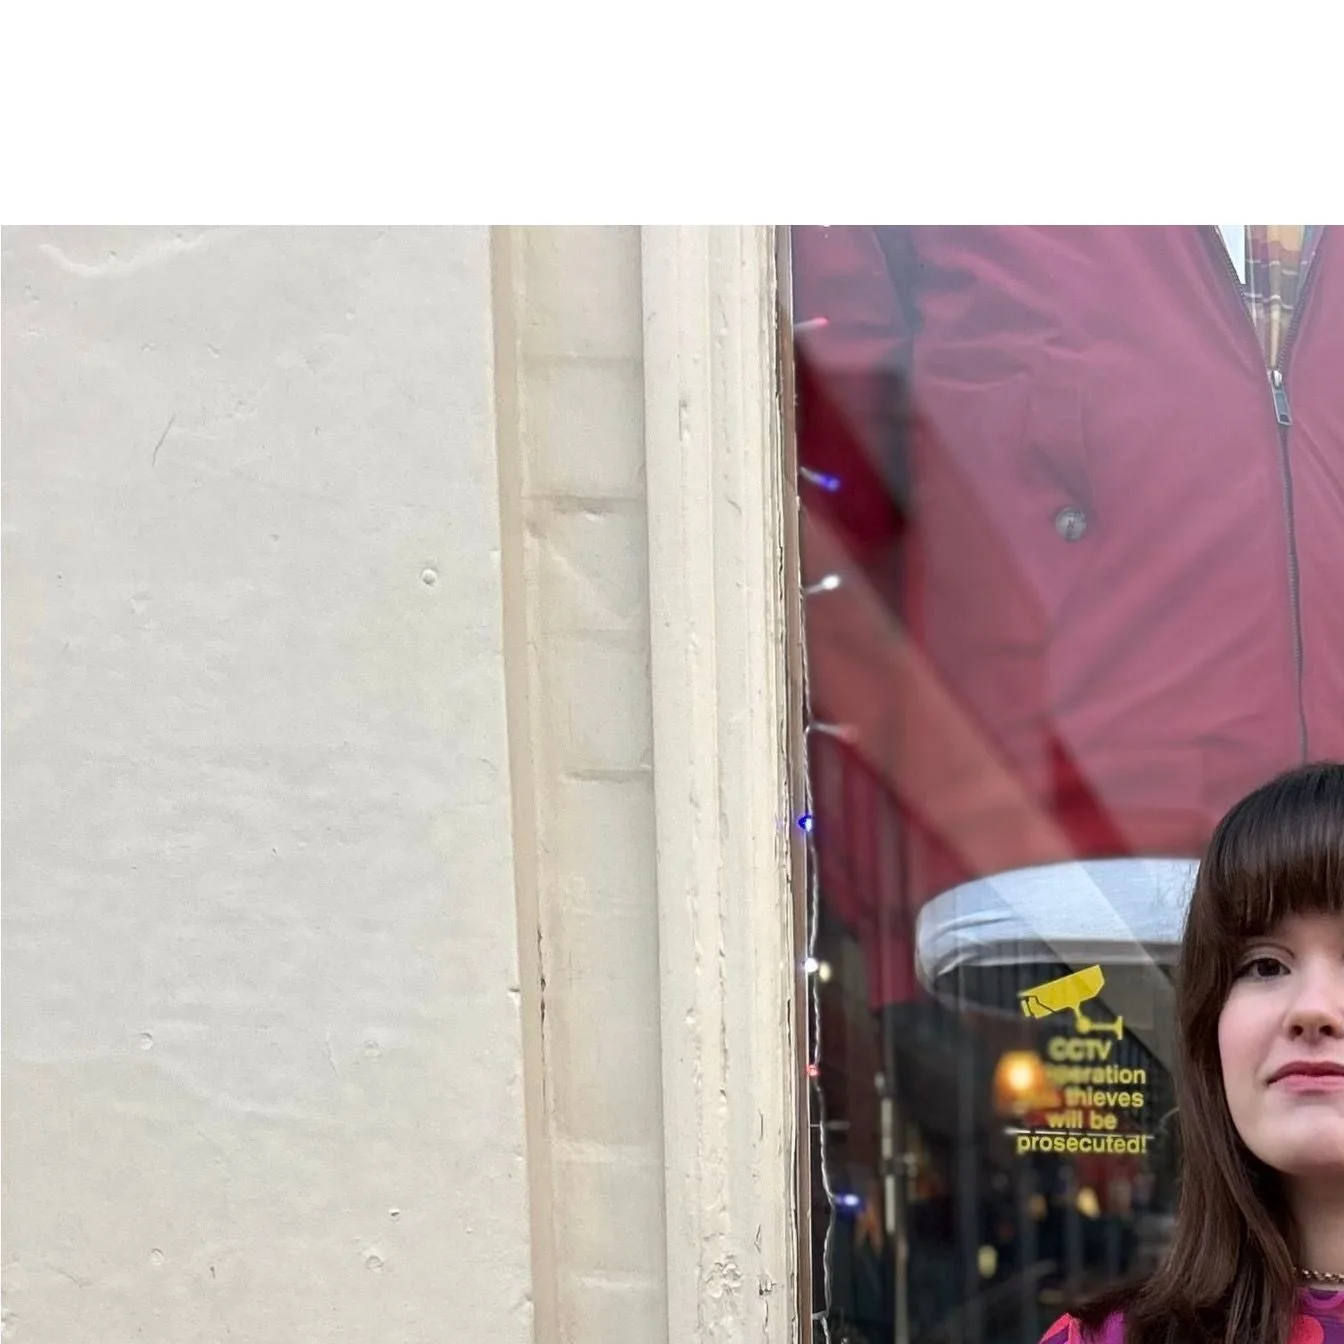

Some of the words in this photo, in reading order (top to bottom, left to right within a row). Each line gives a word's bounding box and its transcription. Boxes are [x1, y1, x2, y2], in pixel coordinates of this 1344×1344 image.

[1047, 1037, 1112, 1061] CCTV
[1064, 1086, 1145, 1108] thieves
[1046, 1109, 1083, 1129] will
[1089, 1110, 1118, 1130] be
[1016, 1134, 1147, 1154] prosecuted!
